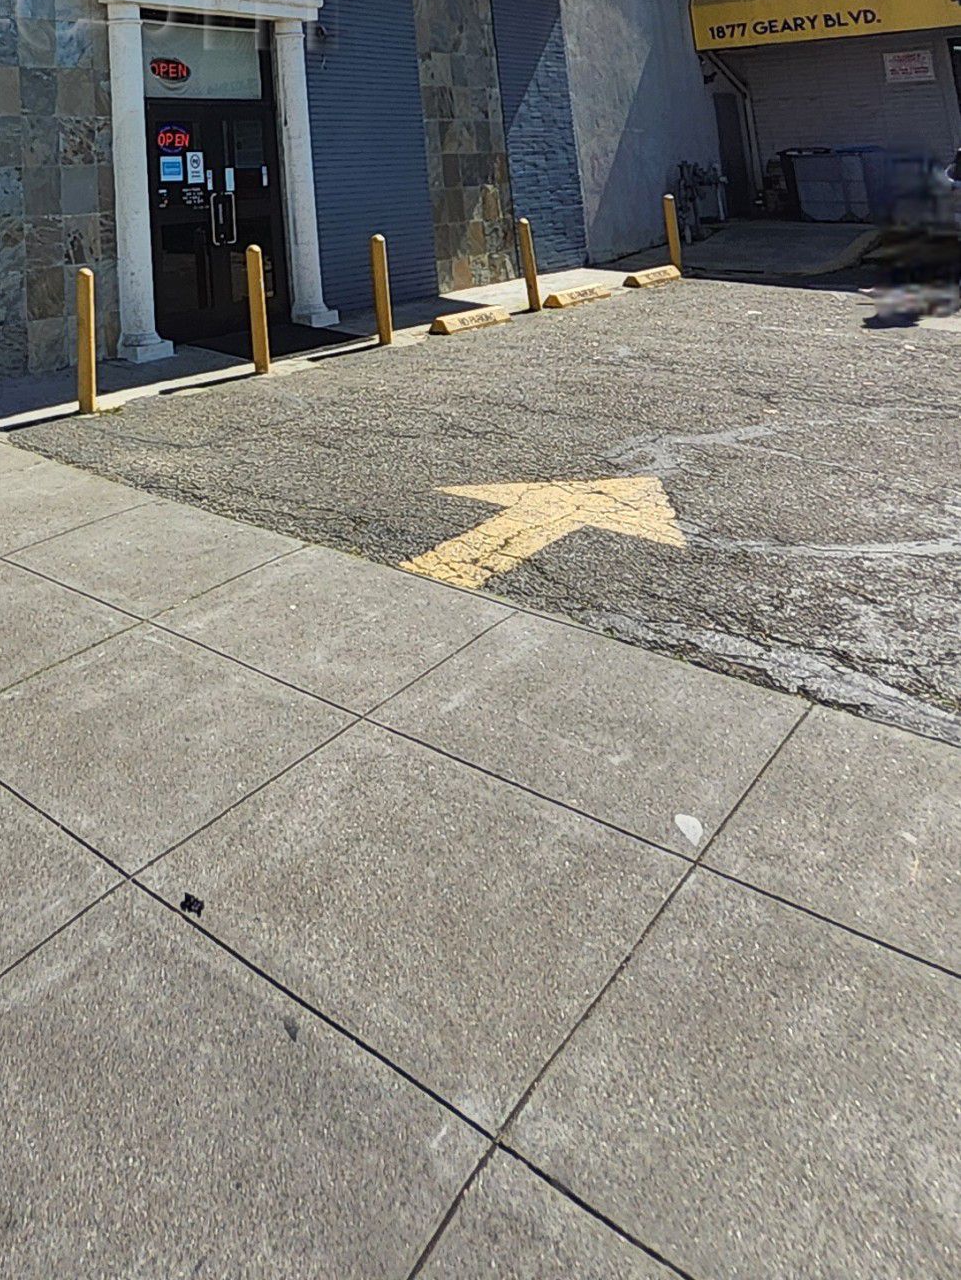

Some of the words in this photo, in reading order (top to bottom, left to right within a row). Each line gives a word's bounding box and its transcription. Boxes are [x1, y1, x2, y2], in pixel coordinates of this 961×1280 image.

[709, 23, 747, 40] 1877
[752, 15, 818, 35] GEARY
[823, 9, 881, 29] BLVD.
[158, 133, 190, 148] OPEN
